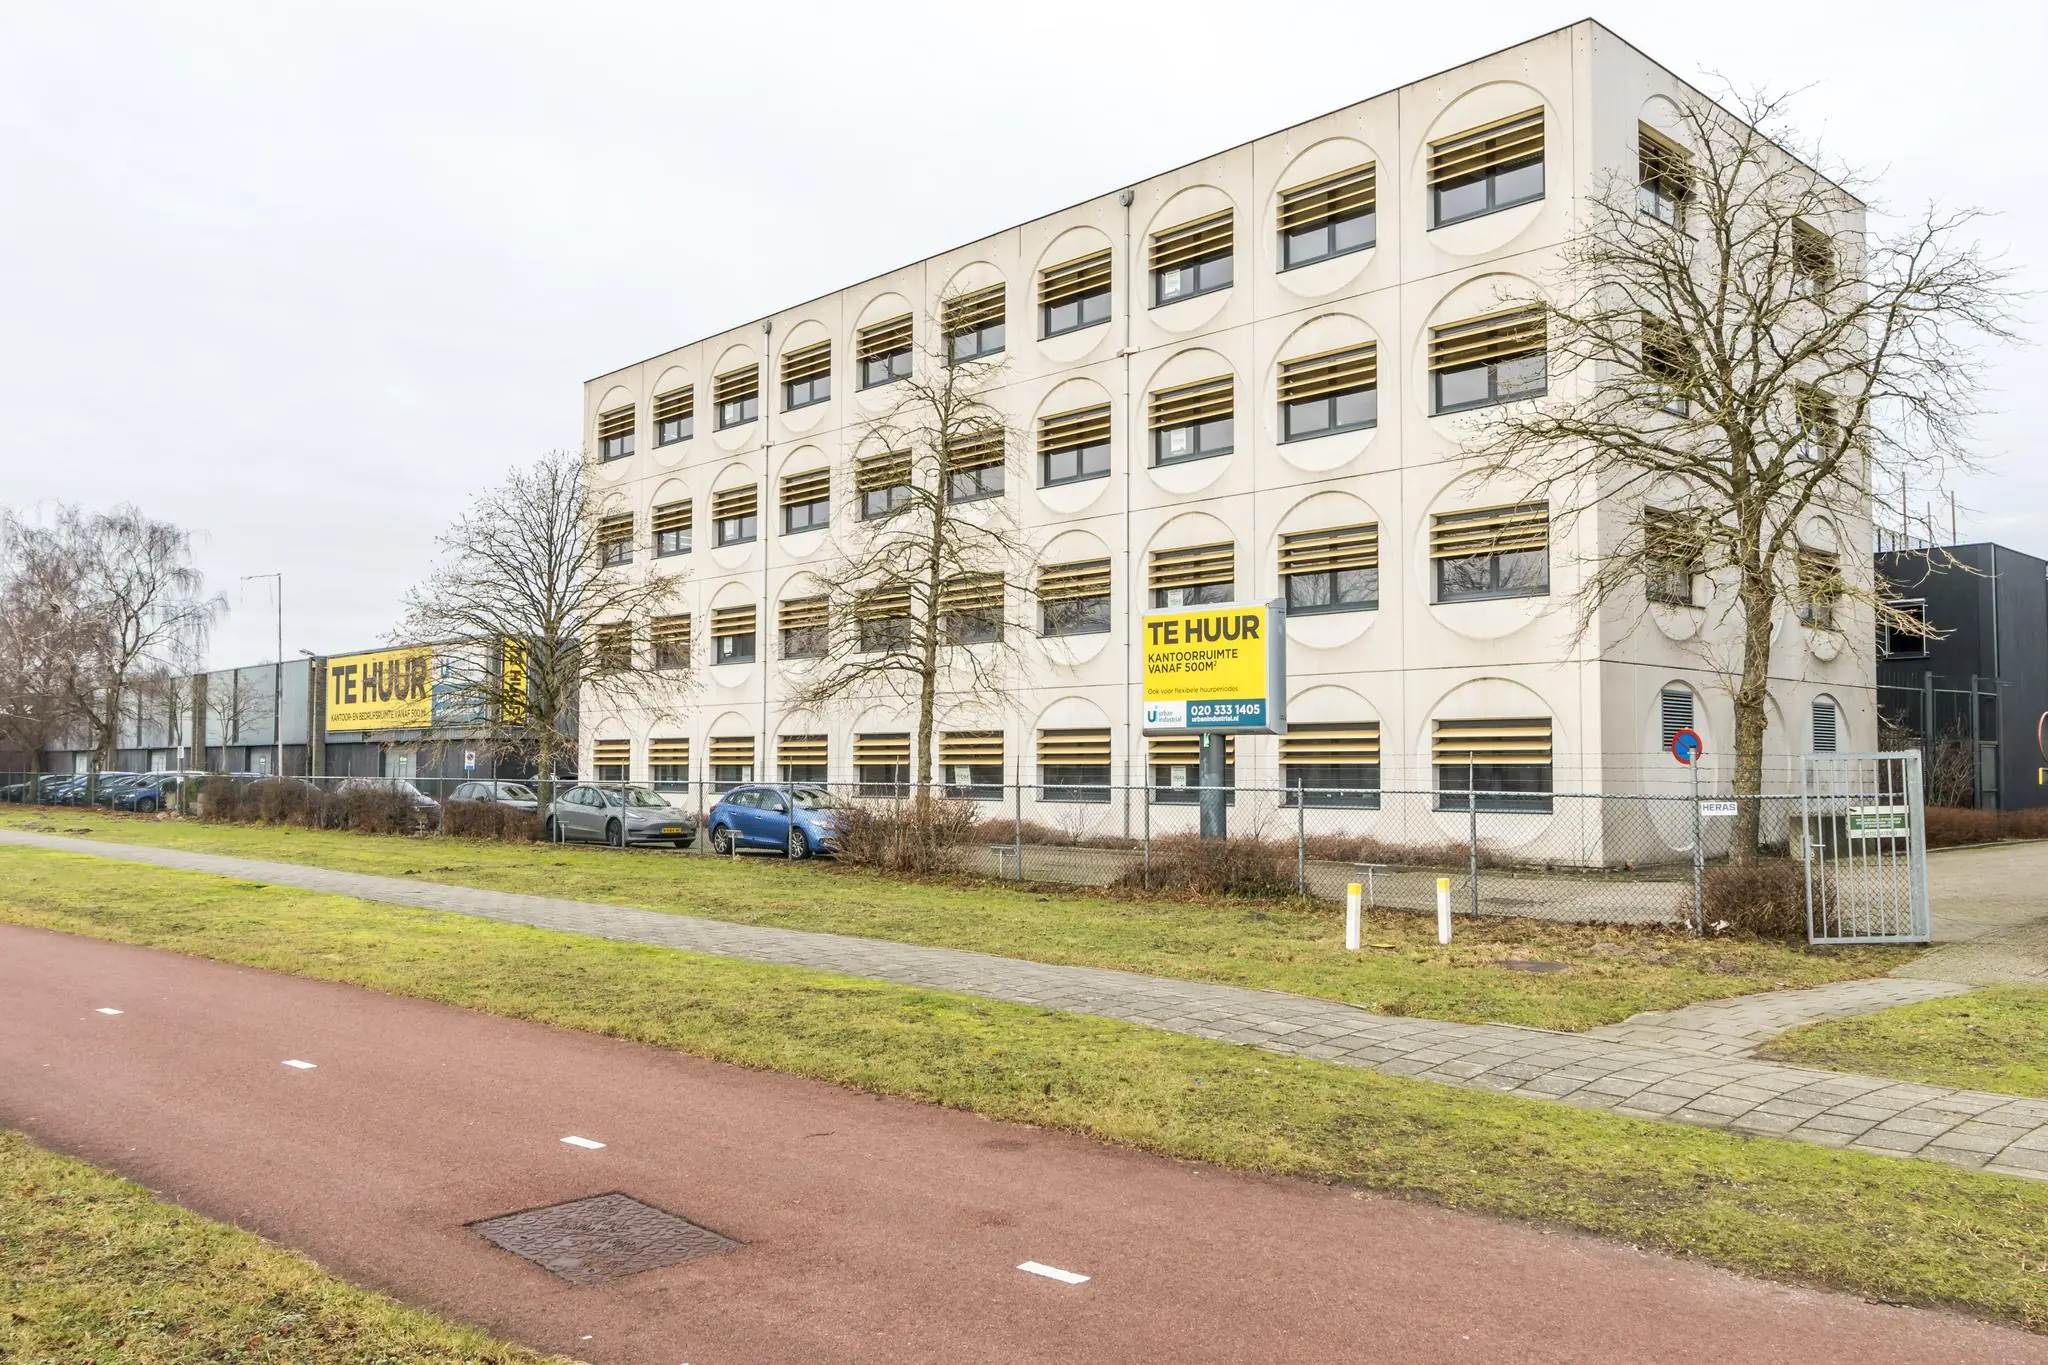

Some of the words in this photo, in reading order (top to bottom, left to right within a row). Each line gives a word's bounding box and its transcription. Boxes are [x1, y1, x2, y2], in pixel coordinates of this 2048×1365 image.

[1147, 620, 1179, 646] TE
[1185, 615, 1260, 643] HUUR
[1147, 648, 1239, 663] KANTOORRUIMTE
[1148, 663, 1182, 674] VANAF
[331, 664, 358, 706] TE
[362, 657, 427, 703] HUUR
[1147, 687, 1160, 696] Ook
[1160, 687, 1174, 695] voor
[1174, 686, 1199, 695] flexibele
[1199, 685, 1239, 695] huurperiodes
[1190, 705, 1211, 716] 020
[1214, 705, 1233, 715] 333
[1235, 703, 1261, 715] 1405
[1191, 715, 1240, 723] urbanindustrial.nl
[1702, 803, 1736, 812] HERAS
